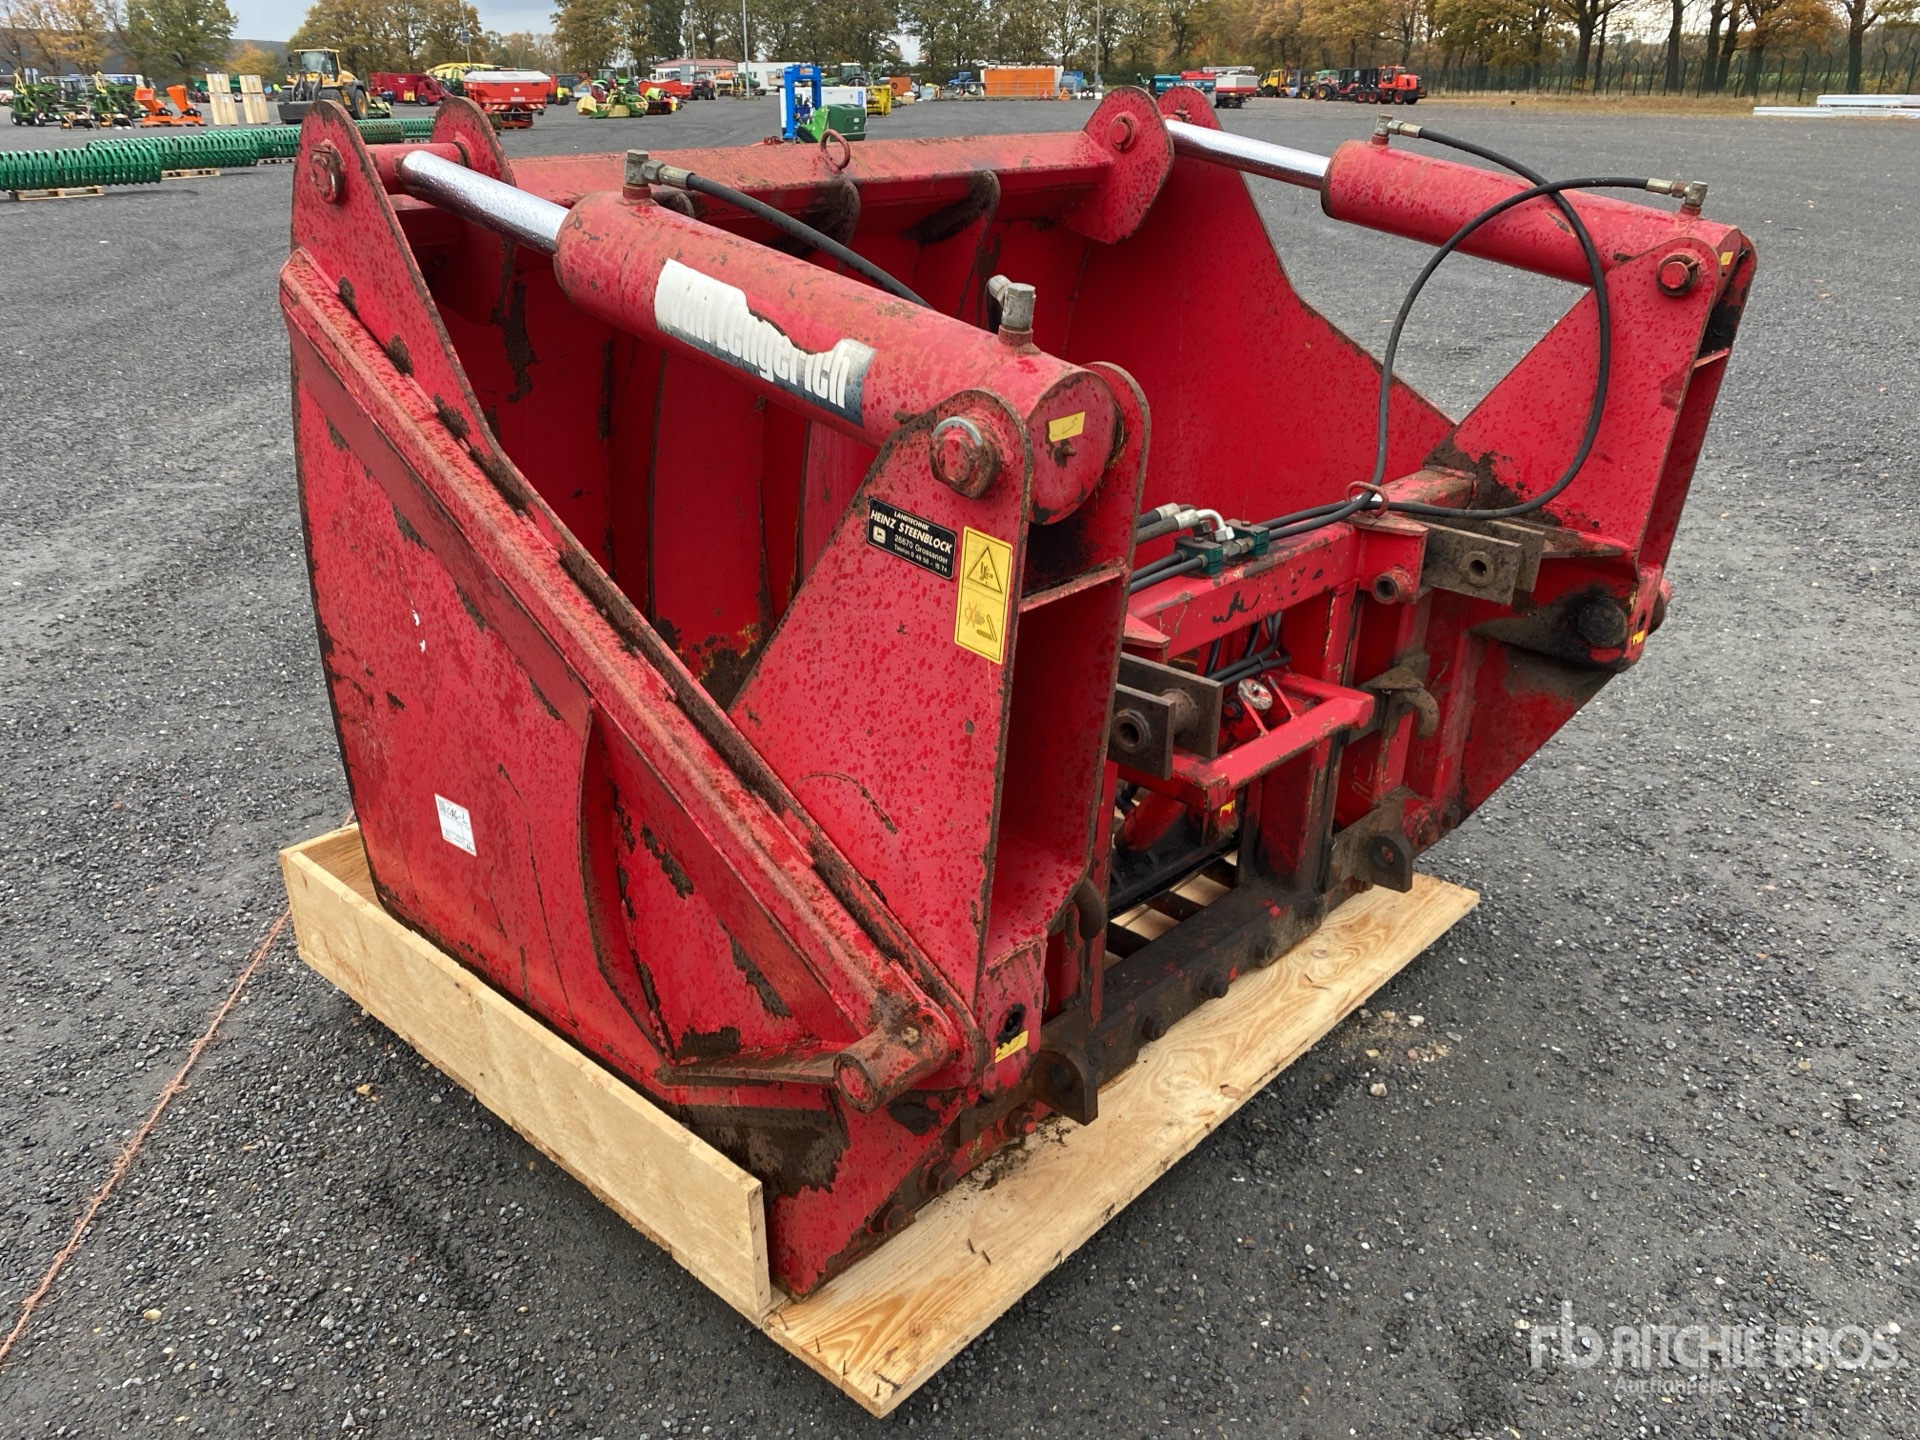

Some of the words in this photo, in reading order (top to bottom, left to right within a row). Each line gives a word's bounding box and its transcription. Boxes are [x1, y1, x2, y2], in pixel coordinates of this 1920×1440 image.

[870, 509, 897, 529] HEINZ
[898, 522, 953, 554] STEENBLOCK
[894, 511, 929, 531] LANDTECHNIK
